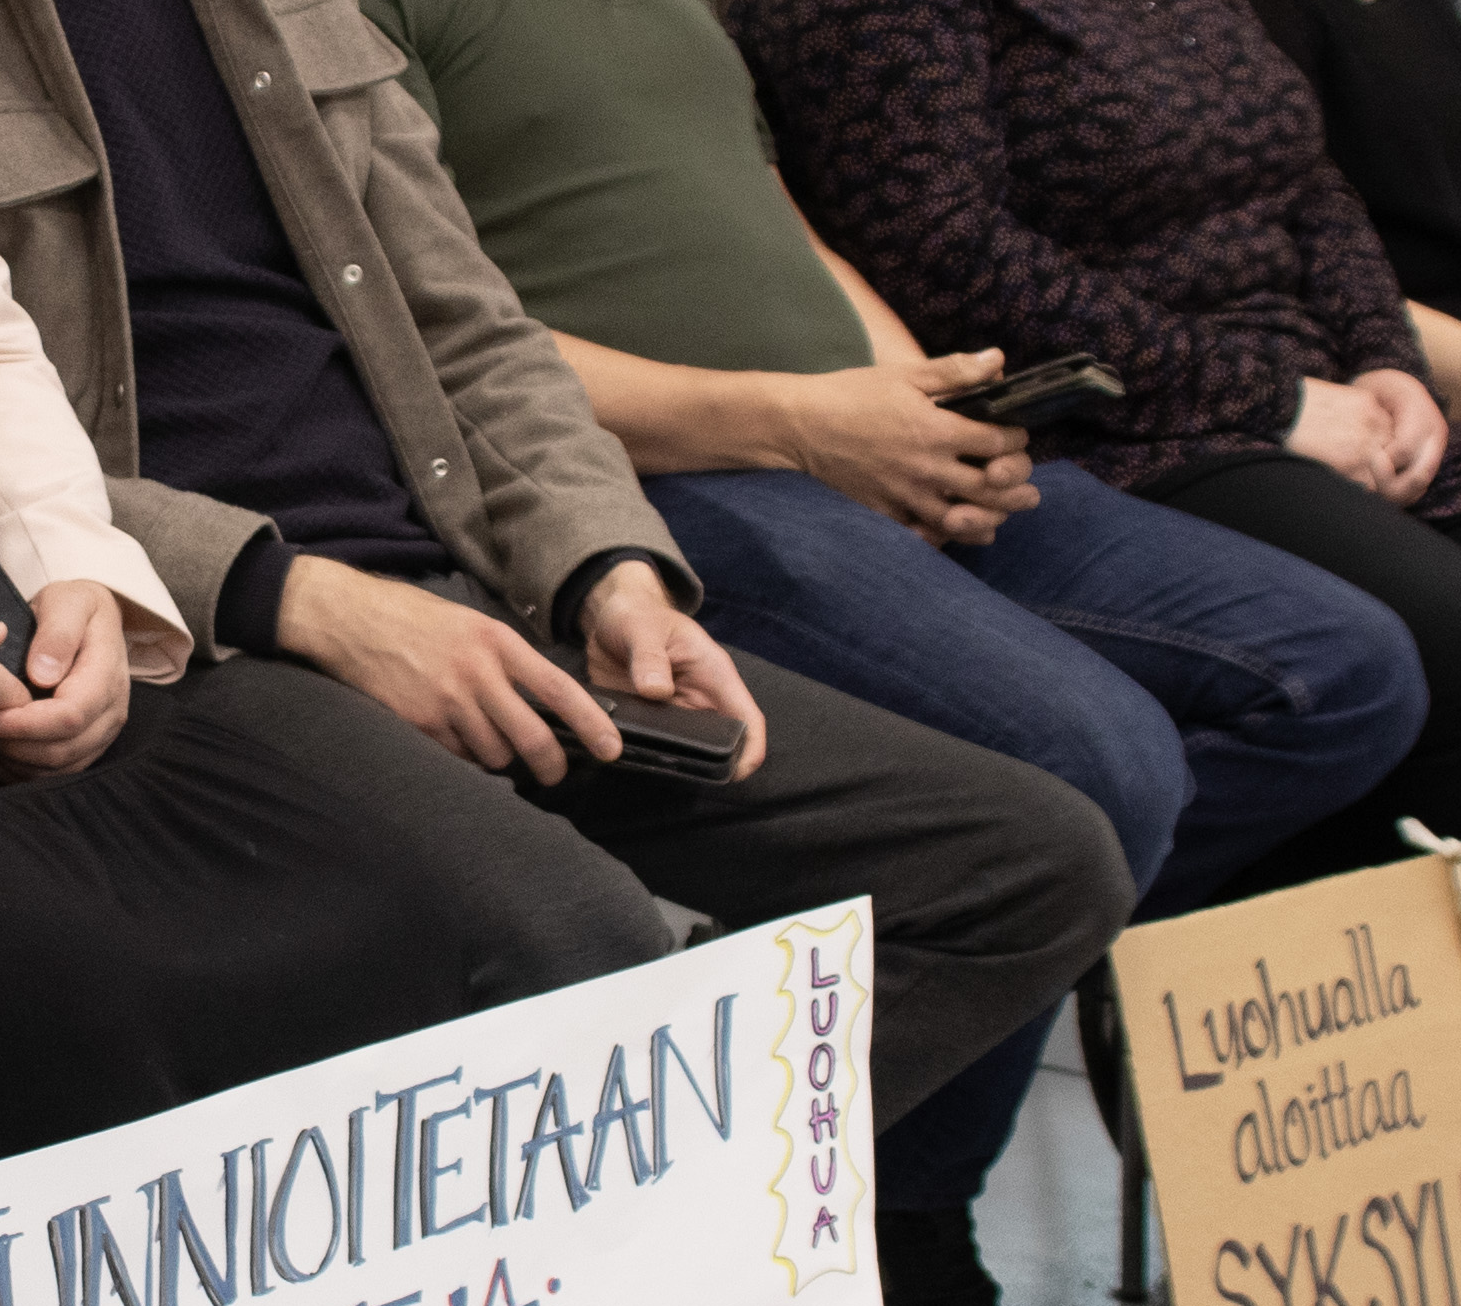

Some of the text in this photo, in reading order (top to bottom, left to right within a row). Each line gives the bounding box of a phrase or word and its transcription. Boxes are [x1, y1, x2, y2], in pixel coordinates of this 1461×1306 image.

[1162, 923, 1422, 1092] Luohualla
[808, 945, 840, 1247] LUOHUA
[1234, 1060, 1427, 1184] aloittaa
